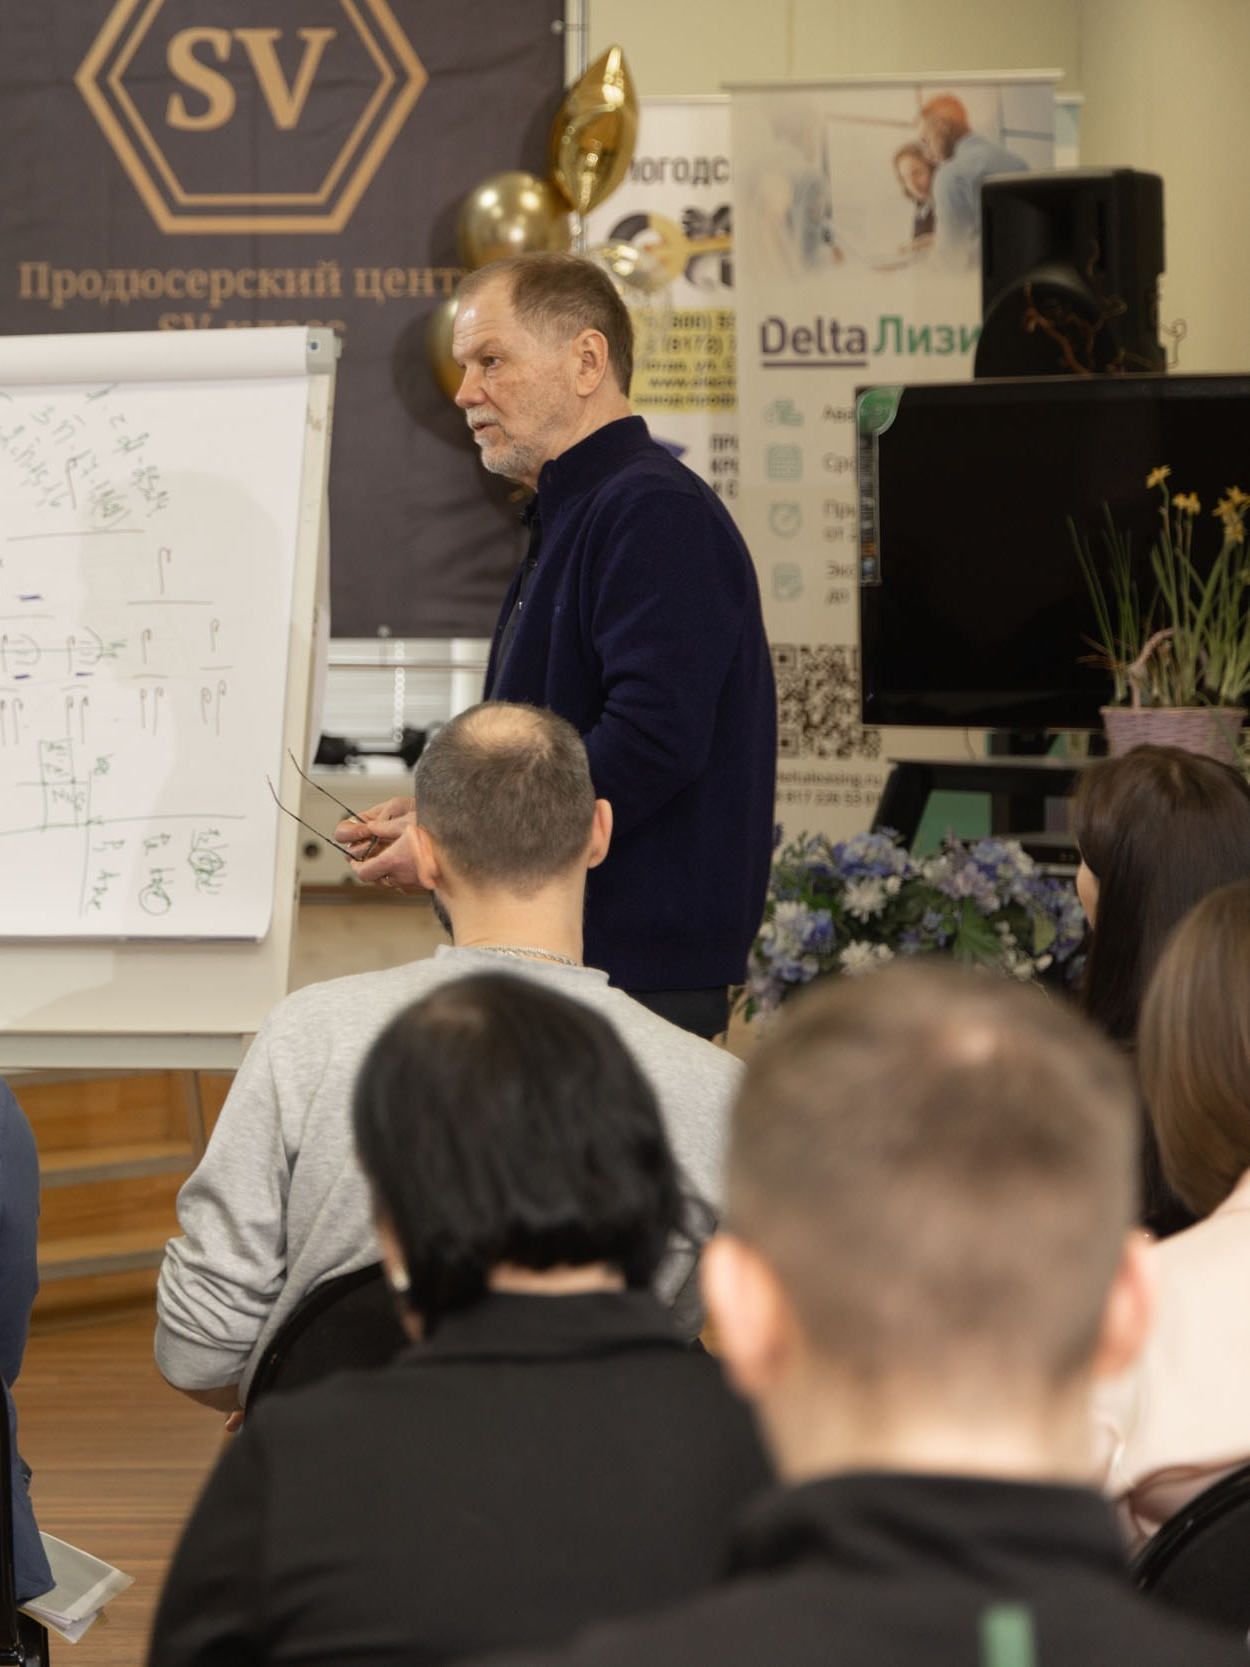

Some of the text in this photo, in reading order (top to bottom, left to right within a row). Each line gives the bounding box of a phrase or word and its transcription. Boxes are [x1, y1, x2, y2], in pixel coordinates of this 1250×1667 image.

[166, 26, 338, 132] SV
[18, 259, 464, 309] Продюсерский цент
[759, 314, 984, 356] DeltaЛизи
